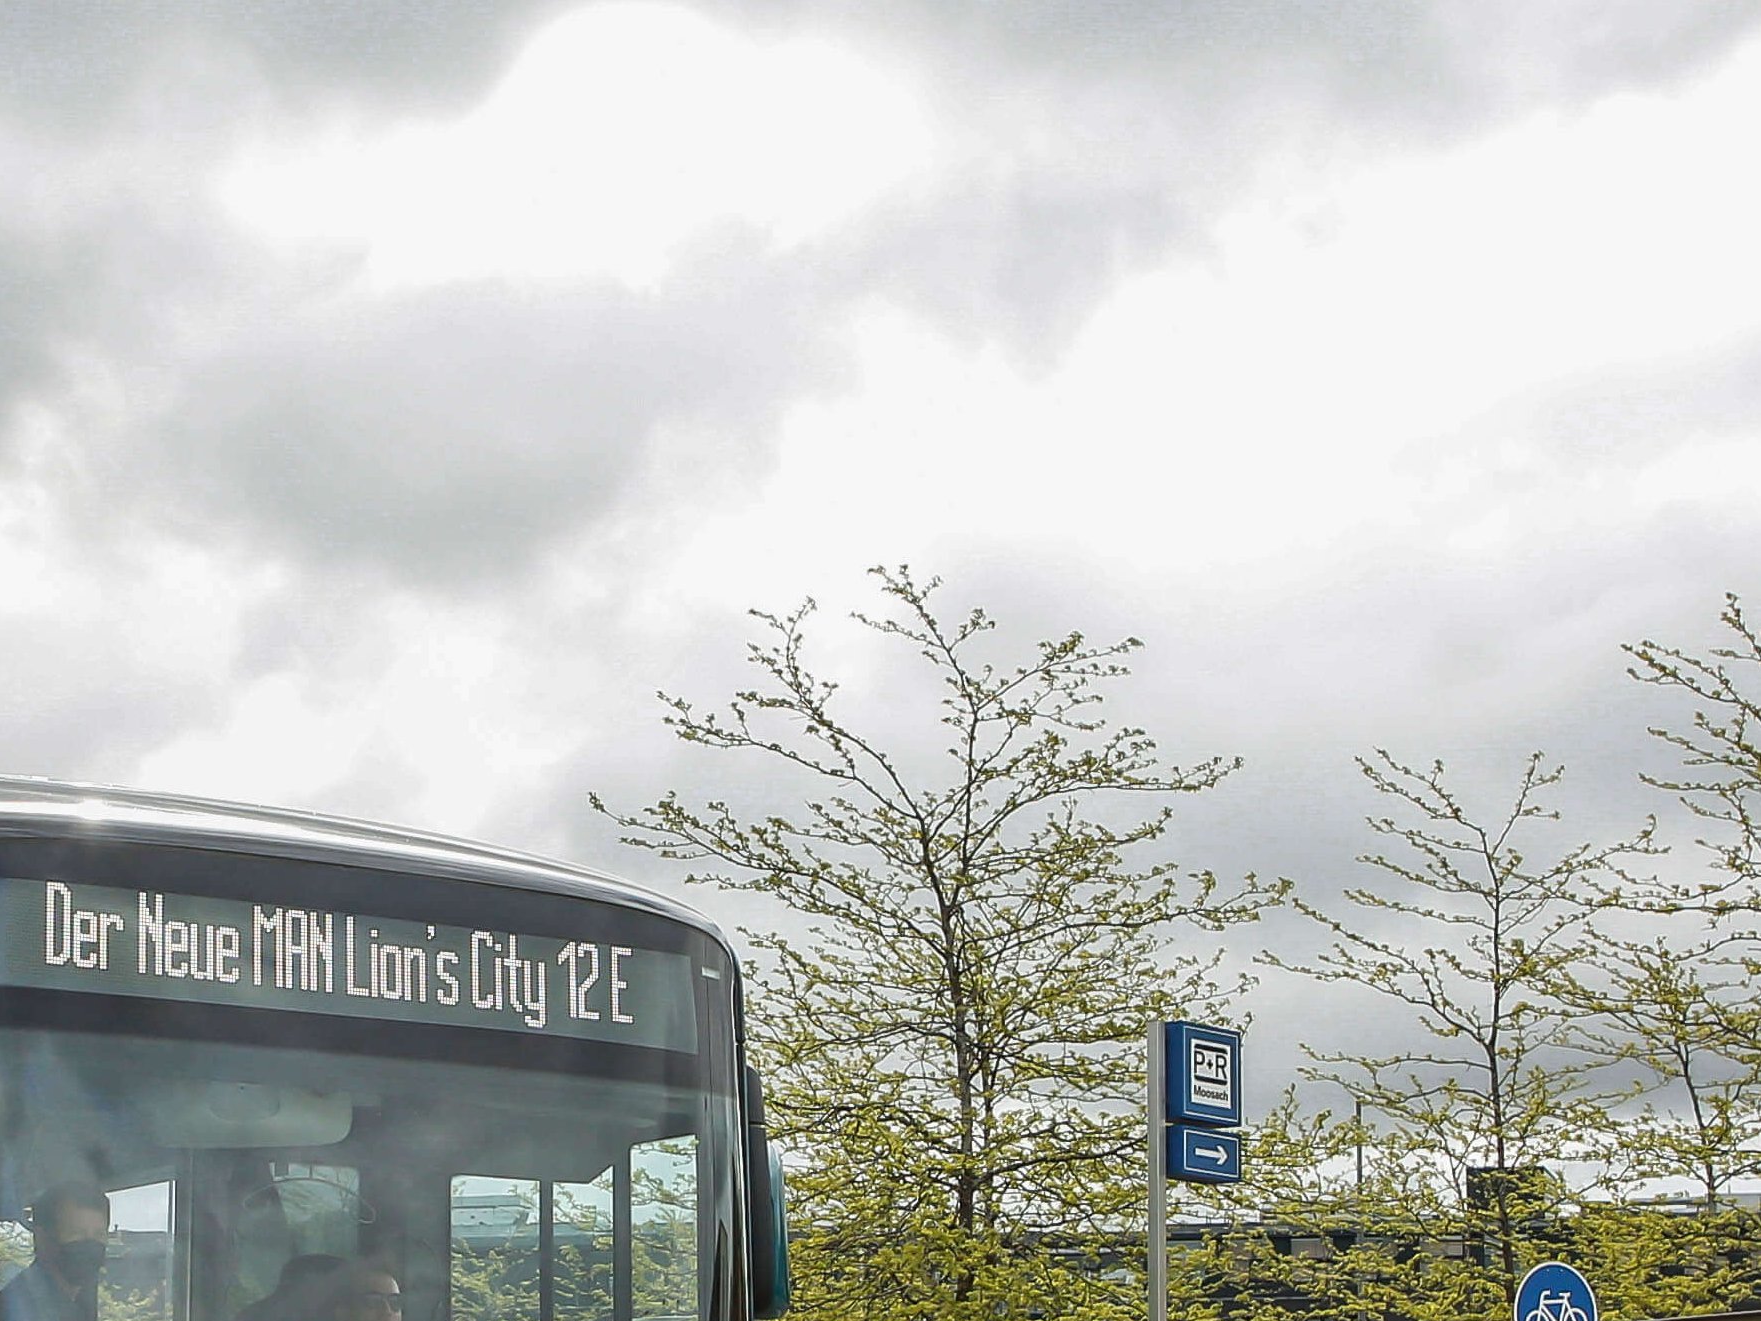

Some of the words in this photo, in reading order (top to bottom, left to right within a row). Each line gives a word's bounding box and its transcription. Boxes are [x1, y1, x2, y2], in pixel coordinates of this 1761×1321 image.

[45, 880, 125, 971] Der
[138, 891, 240, 984] Neue
[253, 904, 333, 994] MAN
[346, 915, 460, 1006] Lion's
[471, 929, 547, 1029] City
[557, 940, 601, 1020] 12
[611, 945, 634, 1024] E
[1194, 1051, 1228, 1079] P+R
[1193, 1084, 1229, 1102] Moosach
